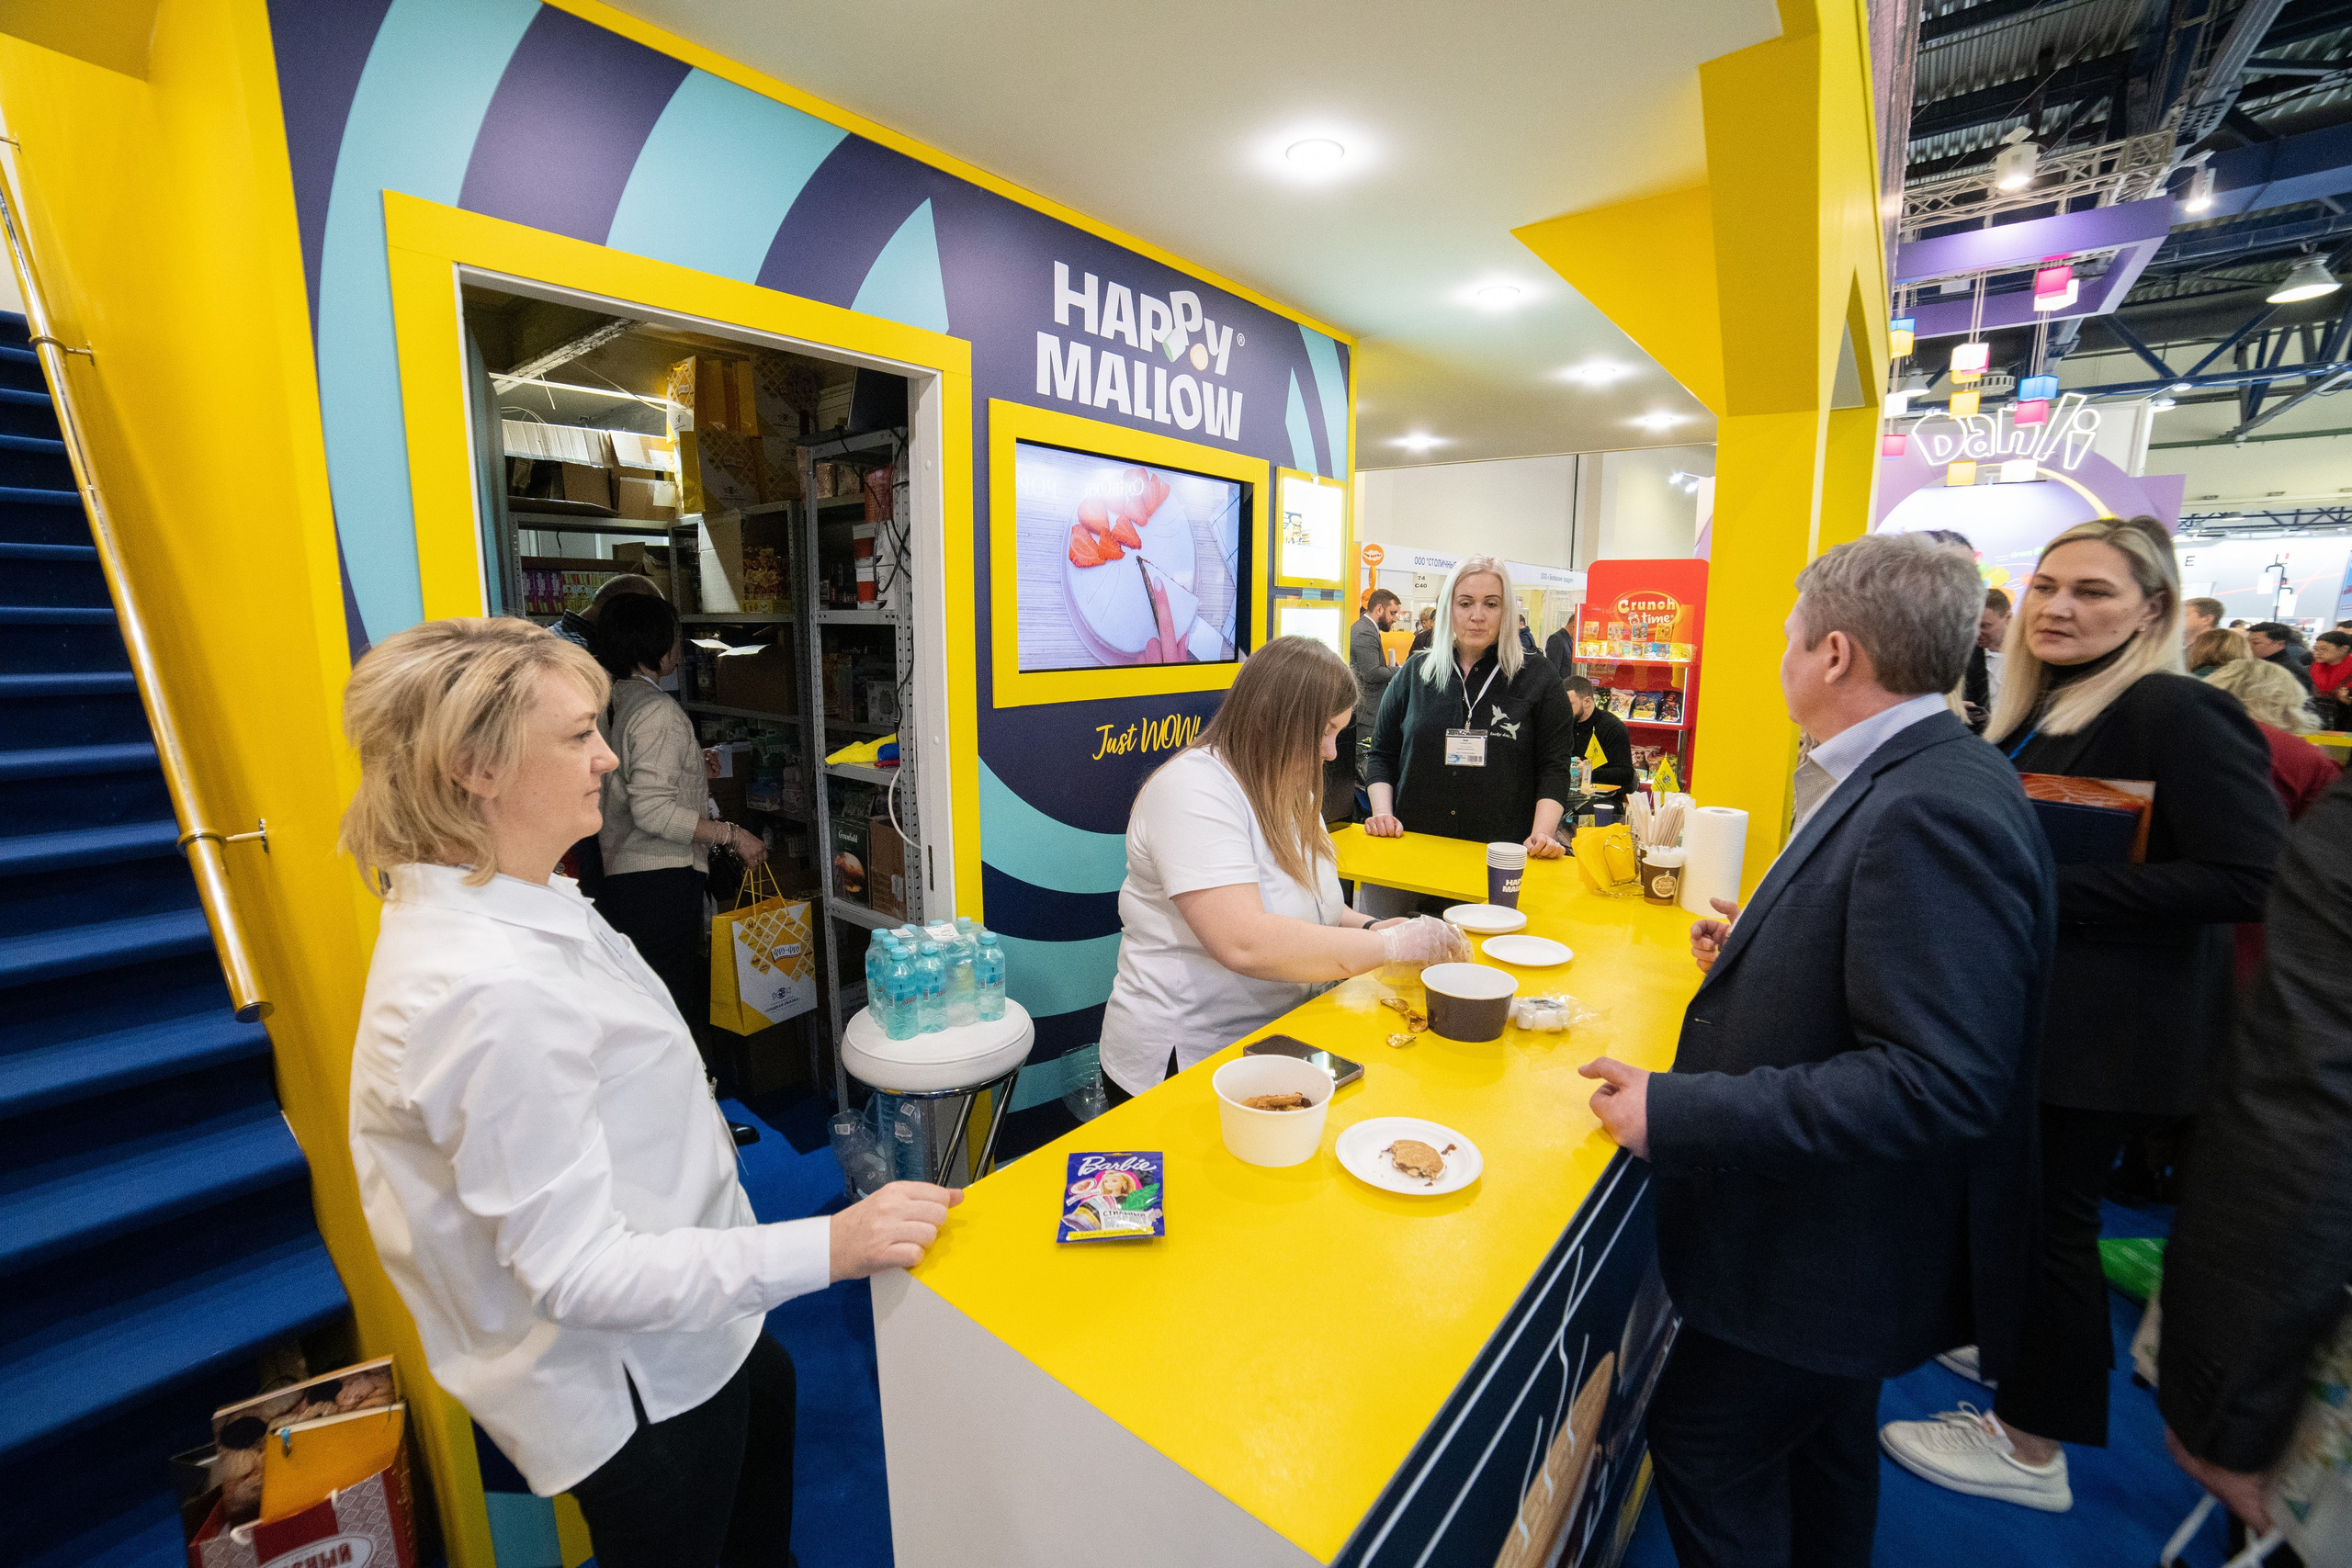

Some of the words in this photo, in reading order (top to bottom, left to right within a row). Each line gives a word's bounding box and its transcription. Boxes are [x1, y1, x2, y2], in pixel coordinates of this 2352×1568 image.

[1054, 260, 1234, 376] HAPPY
[1036, 331, 1243, 442] MALLOW
[1414, 556, 1425, 565] ООО
[1617, 598, 1676, 614] Crunch
[1642, 612, 1670, 625] time
[1092, 723, 1137, 761] Just
[1078, 1156, 1157, 1177] Barbie
